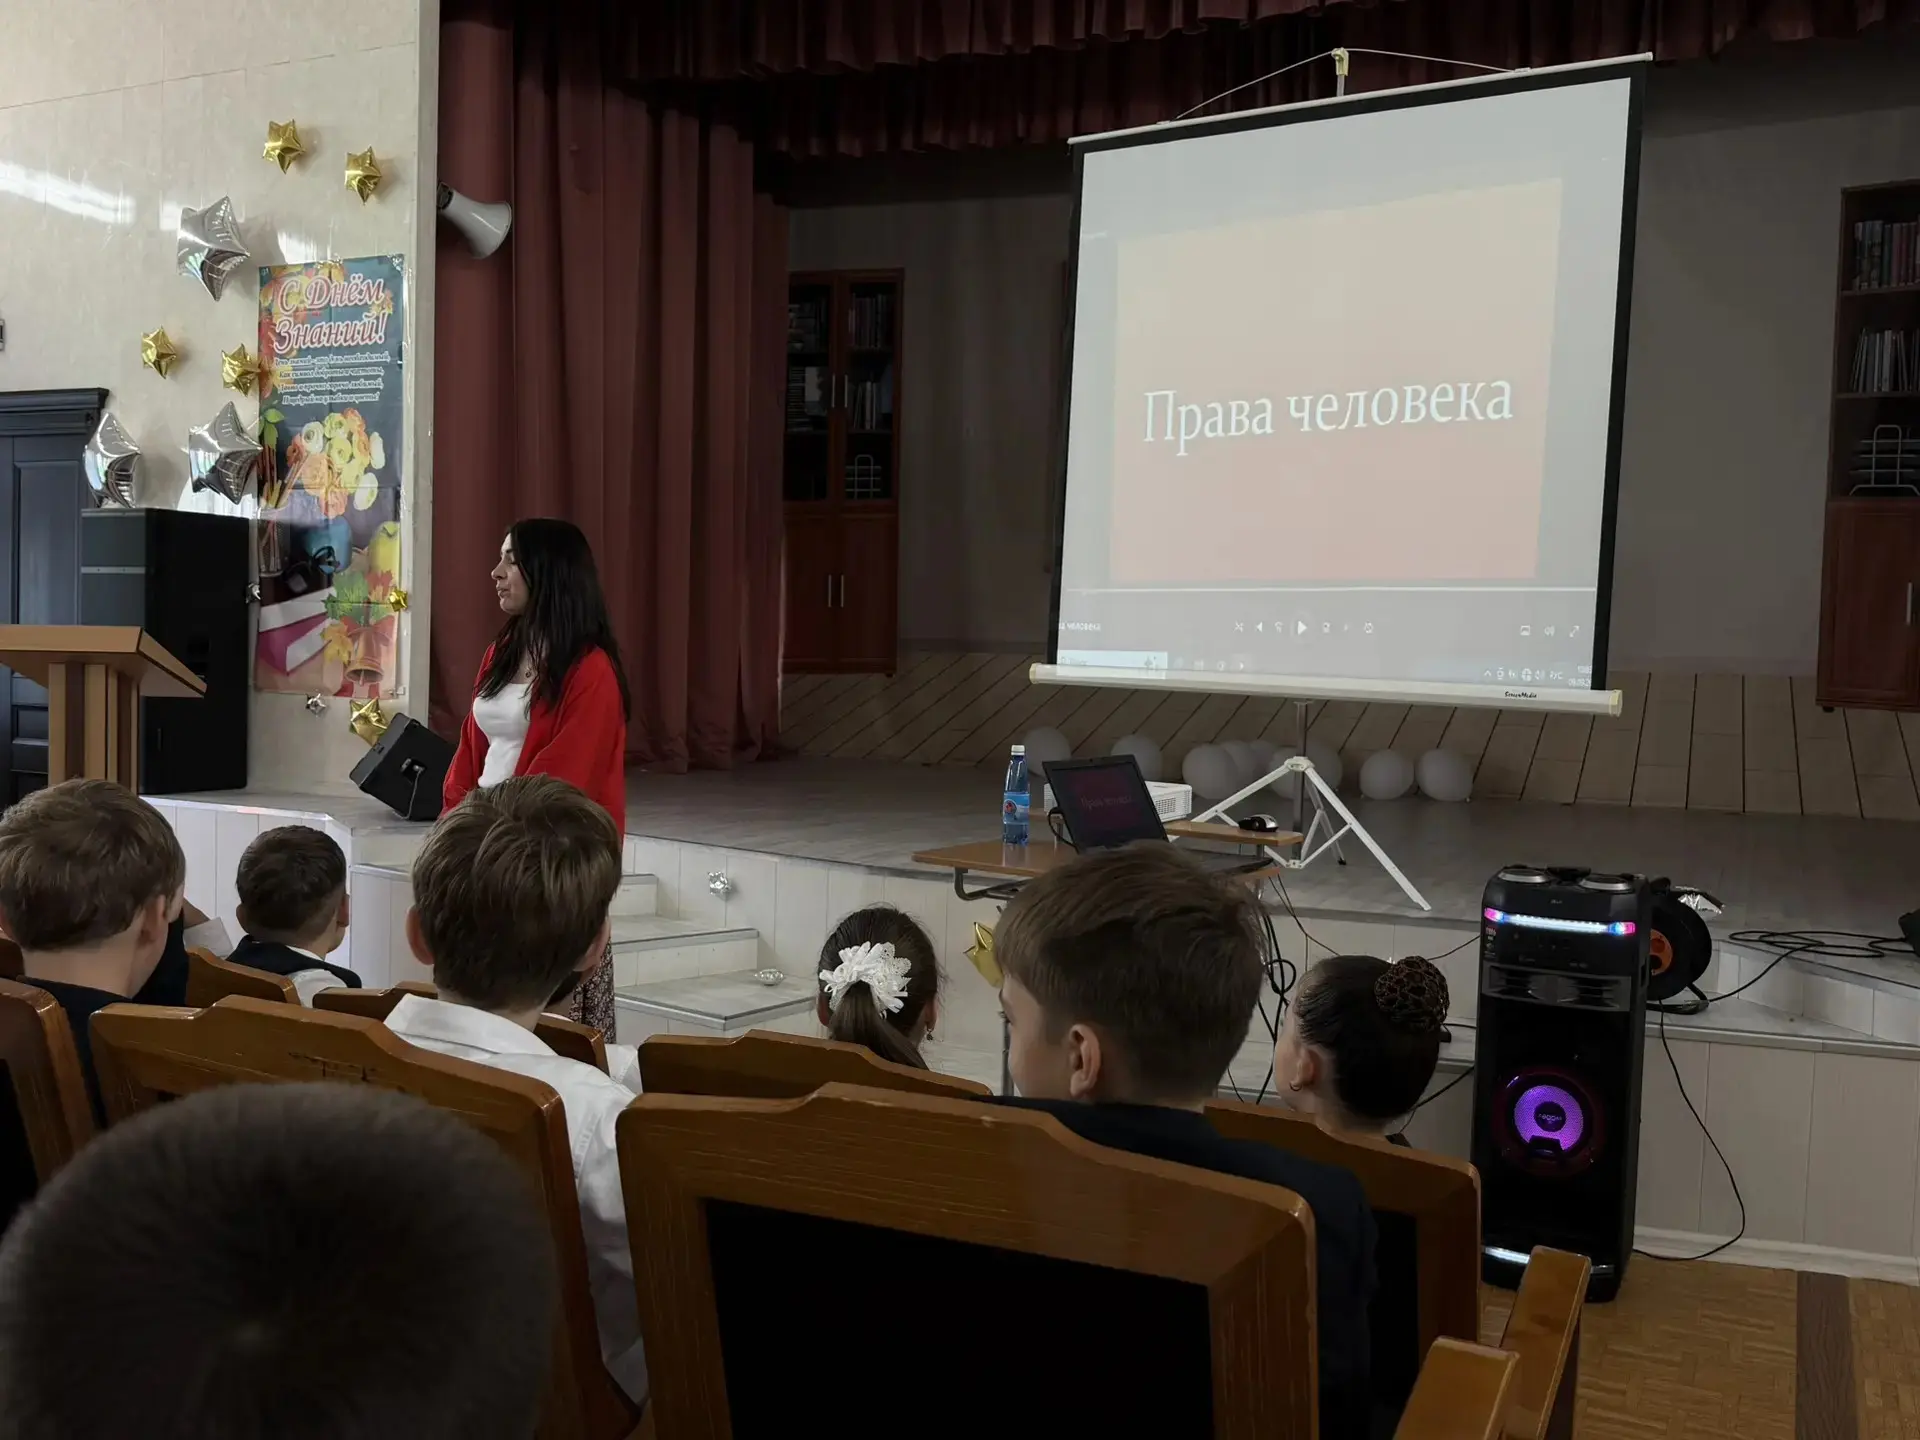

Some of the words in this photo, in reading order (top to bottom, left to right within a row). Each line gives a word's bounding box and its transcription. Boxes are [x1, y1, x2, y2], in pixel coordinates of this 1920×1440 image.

[278, 278, 299, 314] С
[305, 273, 385, 310] Днём
[273, 311, 389, 354] Знаний!
[1142, 389, 1274, 456] Права
[1286, 377, 1515, 433] человека
